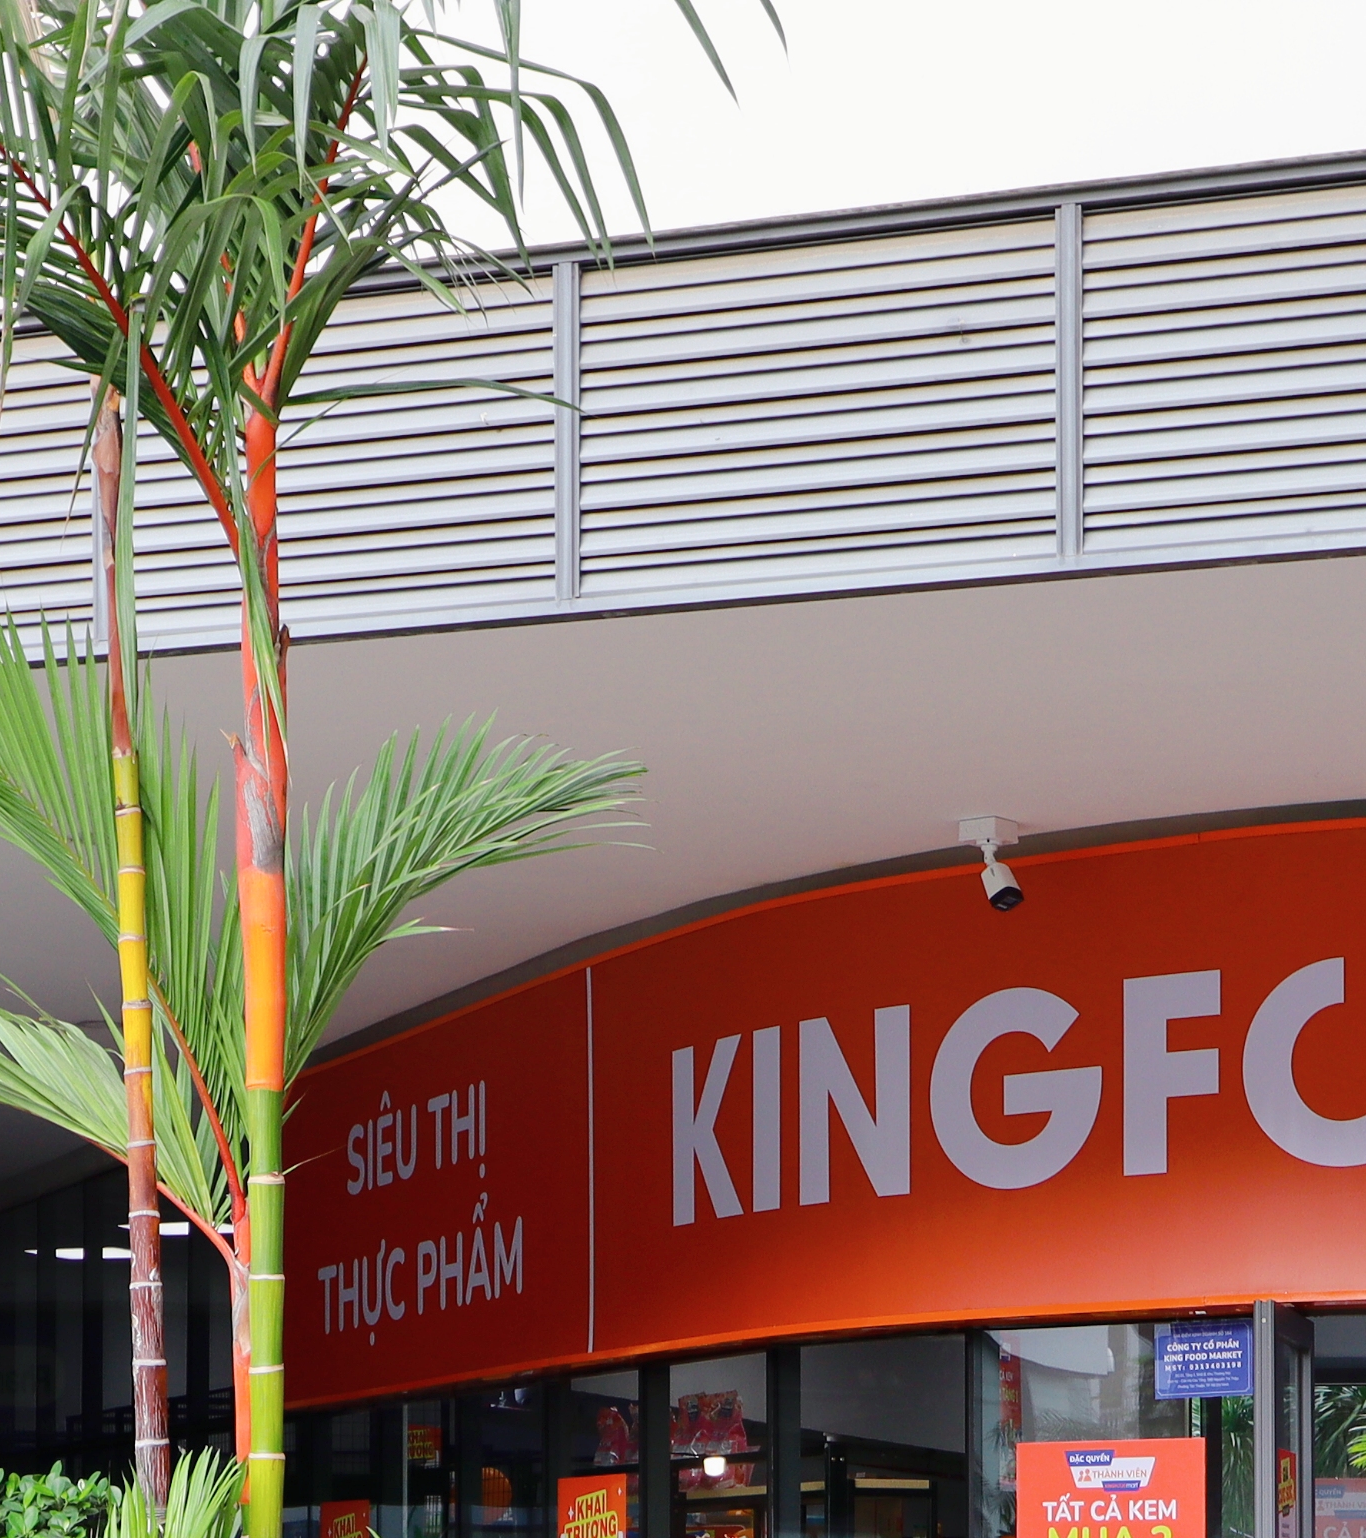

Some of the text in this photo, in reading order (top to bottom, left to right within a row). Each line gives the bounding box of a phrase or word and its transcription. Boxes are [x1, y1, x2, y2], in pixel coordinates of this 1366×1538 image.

[346, 1079, 486, 1196] SIÊU THỊ
[318, 1192, 523, 1346] THỰC PHẨM
[1164, 1351, 1242, 1362] KING FOOD MARKET
[1167, 1342, 1189, 1352] CÔNG
[1069, 1453, 1084, 1465] ĐẶC
[1093, 1467, 1147, 1478] THÀNH VIÊN
[577, 1492, 605, 1520] KHAI
[1042, 1493, 1177, 1522] TẤT CẢ KEM
[334, 1514, 355, 1538] KHAI
